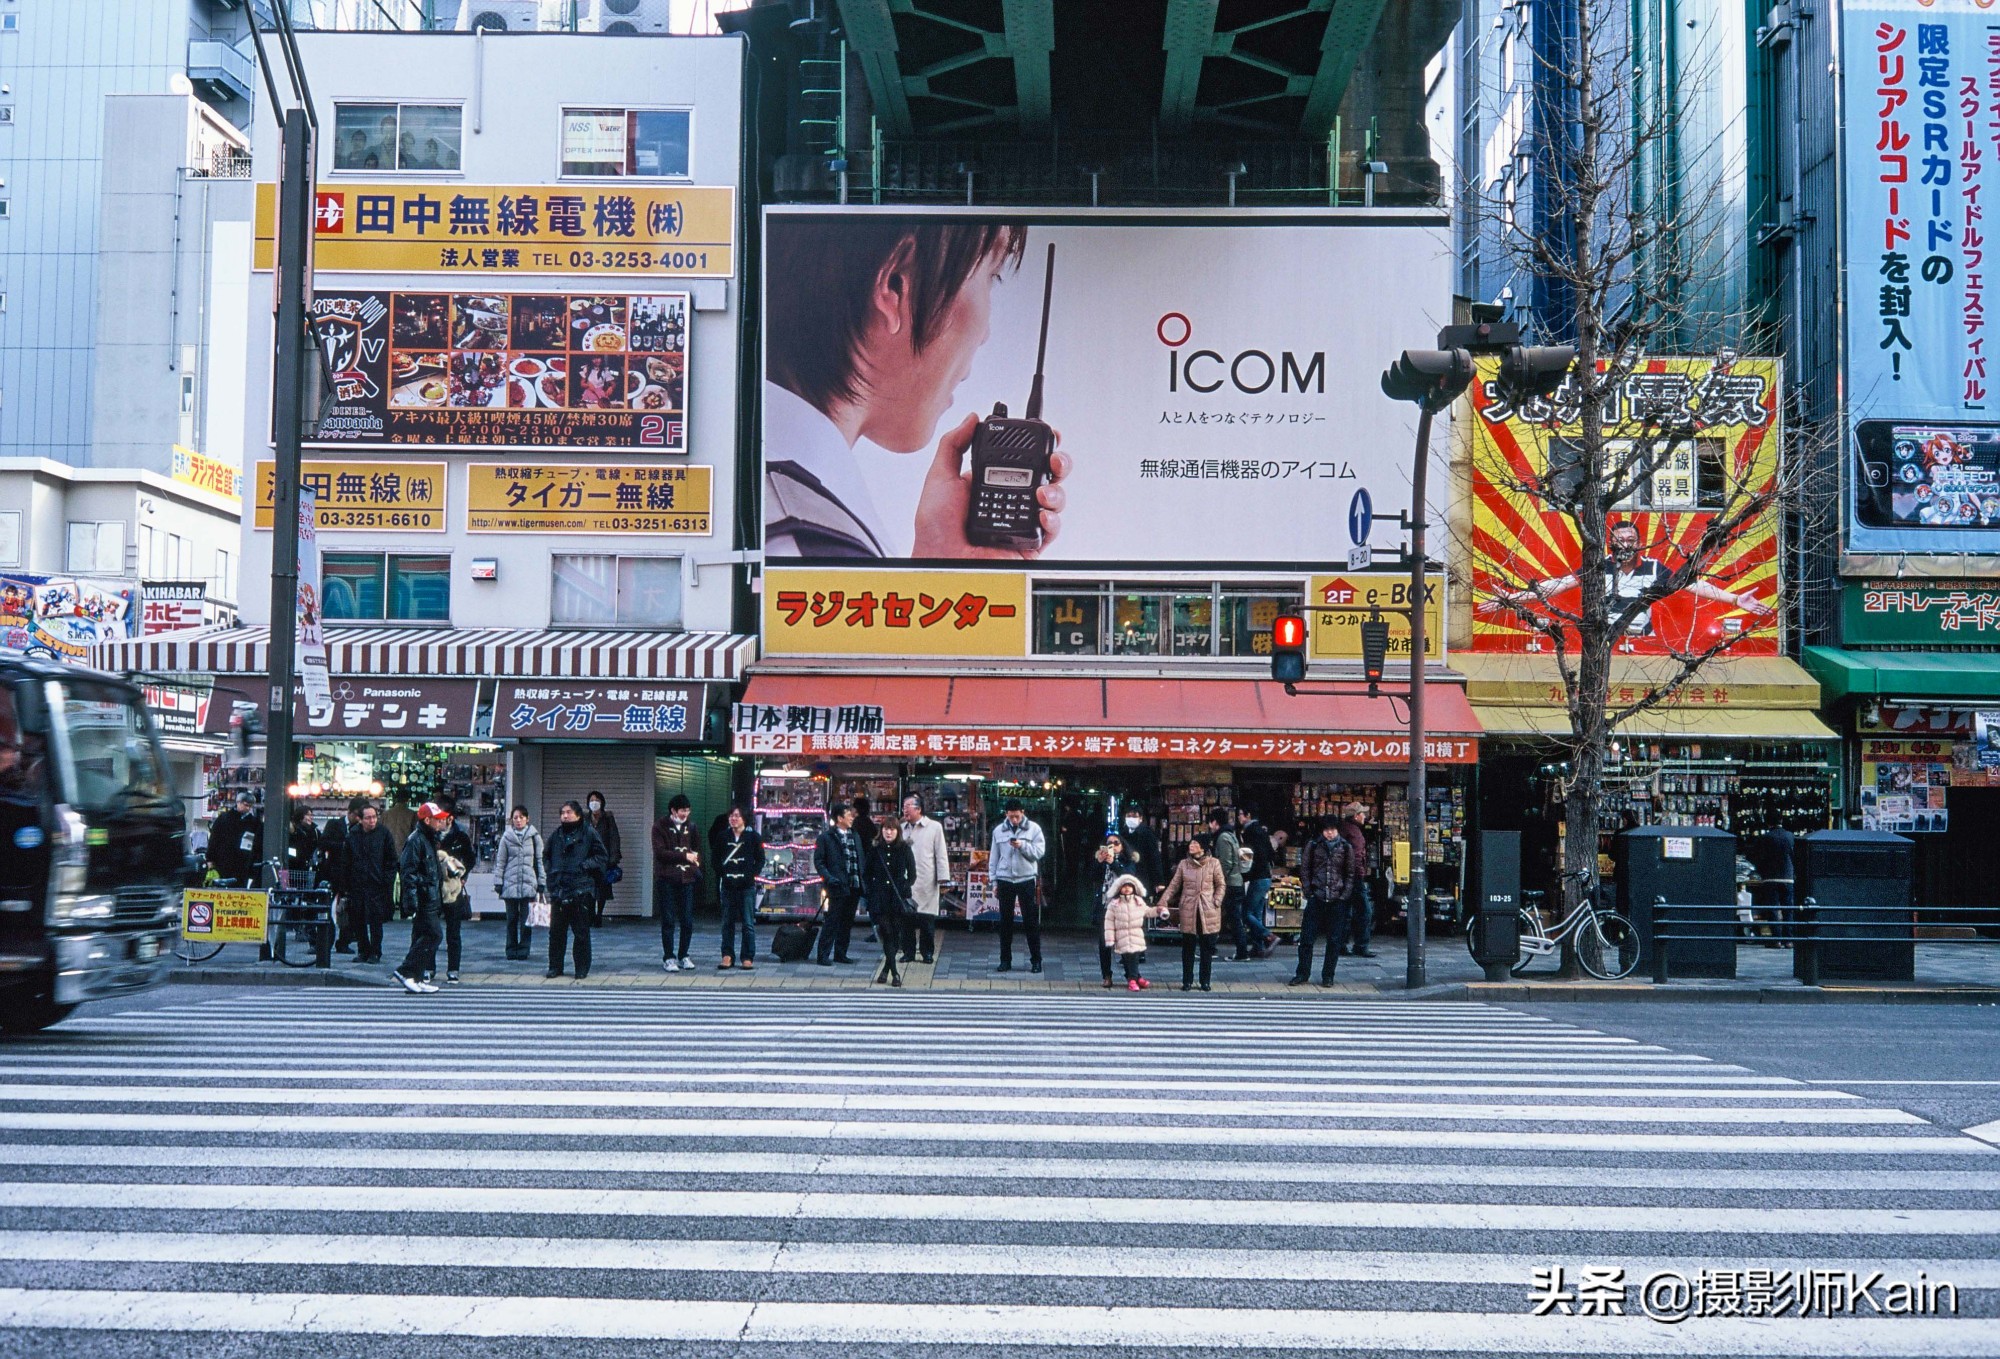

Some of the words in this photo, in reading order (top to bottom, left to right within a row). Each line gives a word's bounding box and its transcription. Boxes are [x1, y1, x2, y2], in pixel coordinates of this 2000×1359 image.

[568, 122, 591, 133] NSS
[1918, 23, 1954, 285] 限定SRカードの
[1876, 22, 1912, 381] シリアルコードを封入!
[440, 248, 521, 269] 法人営業
[533, 252, 562, 267] TEL
[569, 250, 708, 270] 03-3253-4001
[313, 298, 362, 315] イド喫茶
[1159, 410, 1326, 425] 人と人をつなぐテクノロジー
[640, 415, 684, 445] 2F
[494, 467, 686, 482] 熱収縮チューブ・電線・配線器具
[1140, 459, 1358, 480] 無線通信機器のアイコム
[1937, 471, 1996, 482] PERFECT
[266, 471, 433, 505] 田無線(株)
[504, 481, 675, 511] タイガー無線
[320, 512, 431, 527] 03-3251-6610
[471, 516, 587, 531] http://www.tigermusen.com/
[593, 520, 611, 529] TEL
[611, 517, 708, 531] 03-3251-6313
[1351, 549, 1369, 567] 8-20
[1327, 591, 1352, 604] 2F
[144, 602, 202, 622] ホビー
[776, 590, 1017, 631] ラジオセンター
[1175, 632, 1231, 647] コネクー
[363, 687, 421, 698] Panasonic
[513, 687, 688, 701] 熱収縮チューブ・電線・配線器具
[511, 704, 686, 734] タイガー無線
[736, 704, 884, 734] 日本製日用品
[1490, 894, 1512, 903] 103-25
